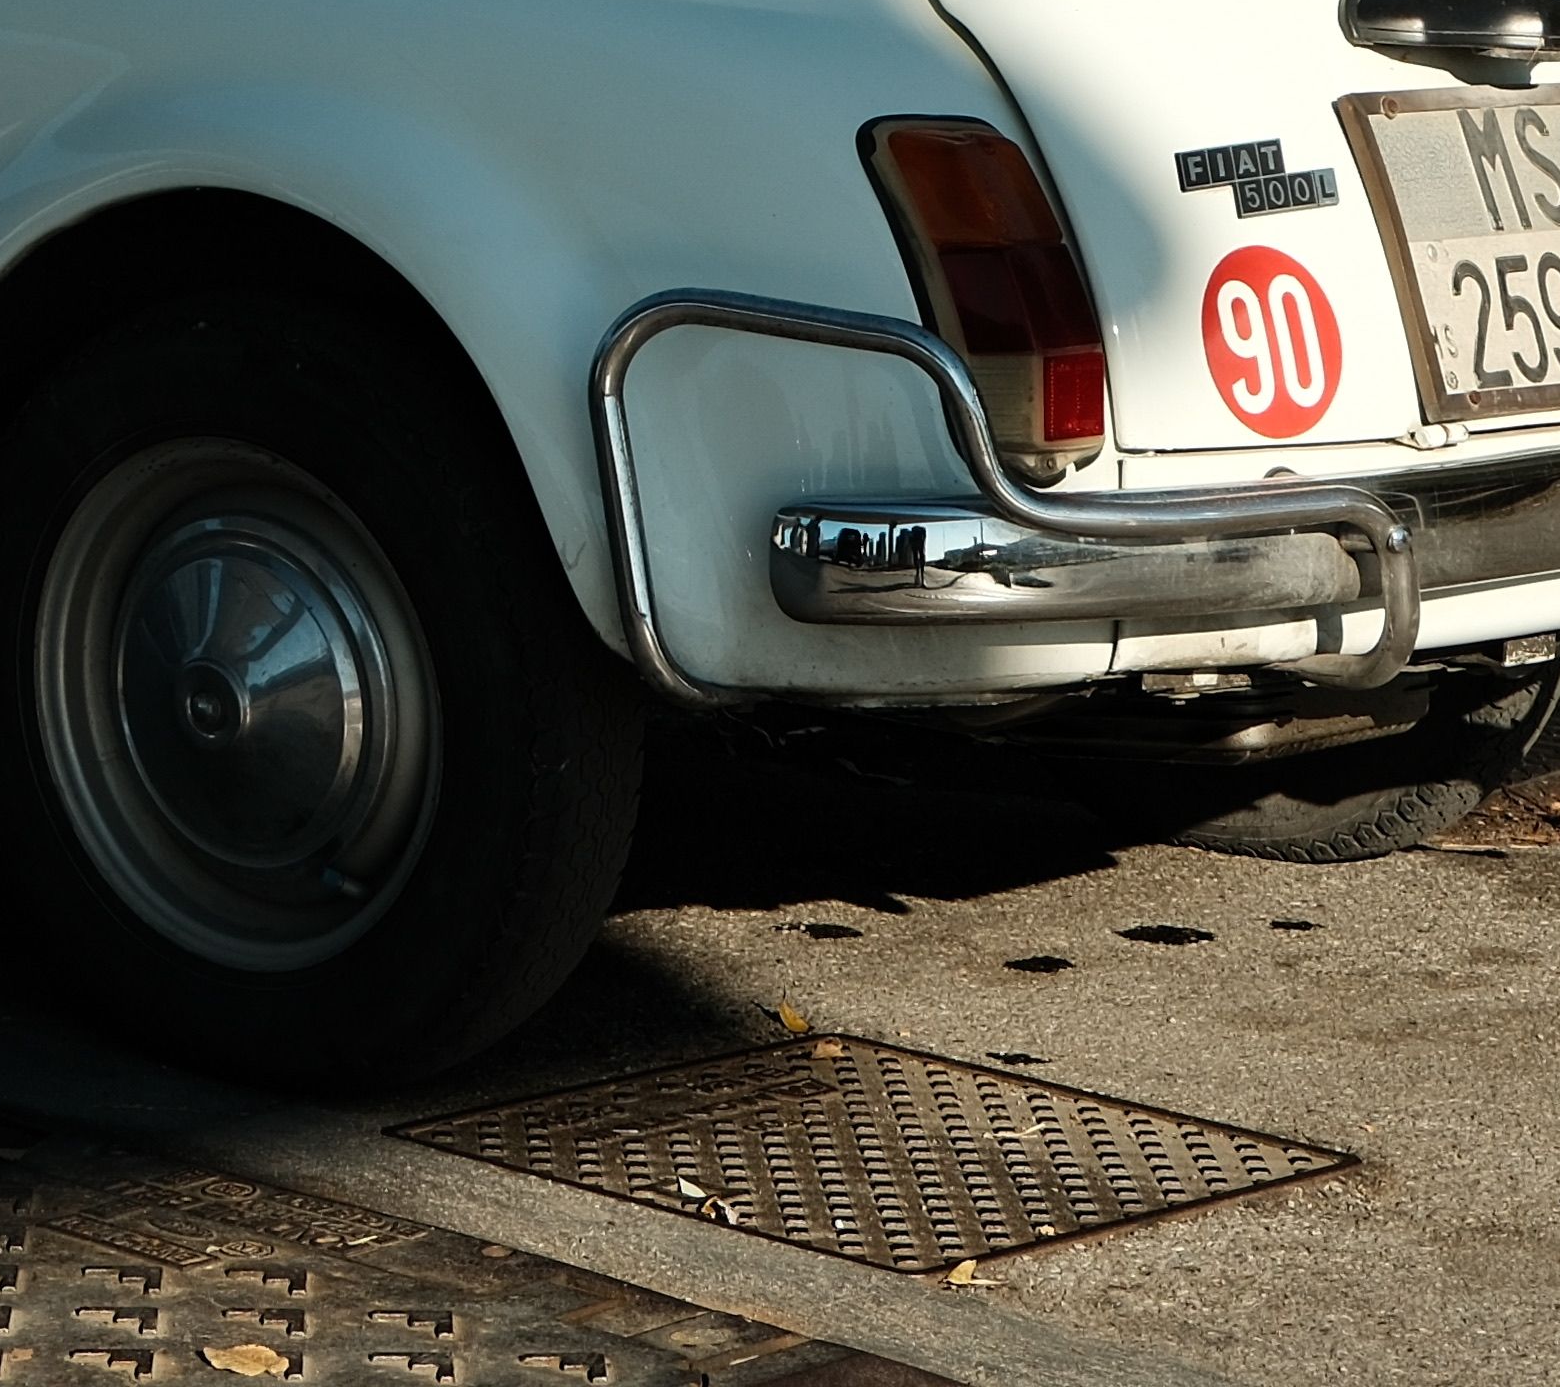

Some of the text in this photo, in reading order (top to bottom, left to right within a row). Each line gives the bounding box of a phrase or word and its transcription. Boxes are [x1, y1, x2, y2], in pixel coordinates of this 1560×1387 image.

[1187, 145, 1278, 181] FIAT
[1245, 174, 1336, 208] 500L
[1216, 272, 1324, 415] 90
